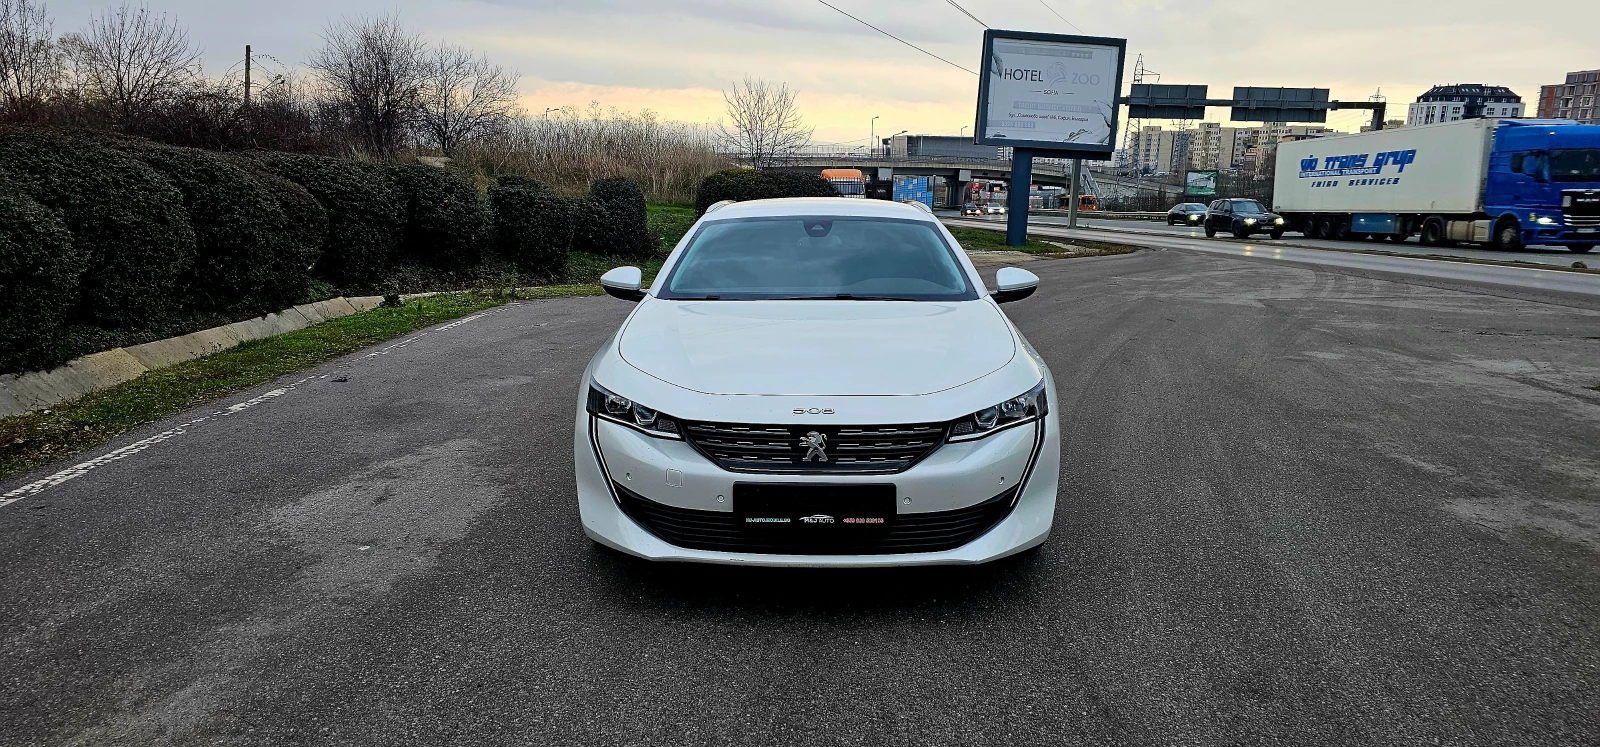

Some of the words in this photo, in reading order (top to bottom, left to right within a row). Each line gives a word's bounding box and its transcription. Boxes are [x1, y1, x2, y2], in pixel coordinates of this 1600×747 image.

[1004, 68, 1044, 82] HOTEL
[1071, 72, 1100, 86] ZOO
[1372, 149, 1417, 174] grup
[1300, 168, 1341, 178] INTERNATIONAL
[1342, 166, 1378, 175] TRANSPORT
[1311, 180, 1339, 188] FRIGO
[1348, 177, 1400, 187] SERVICES
